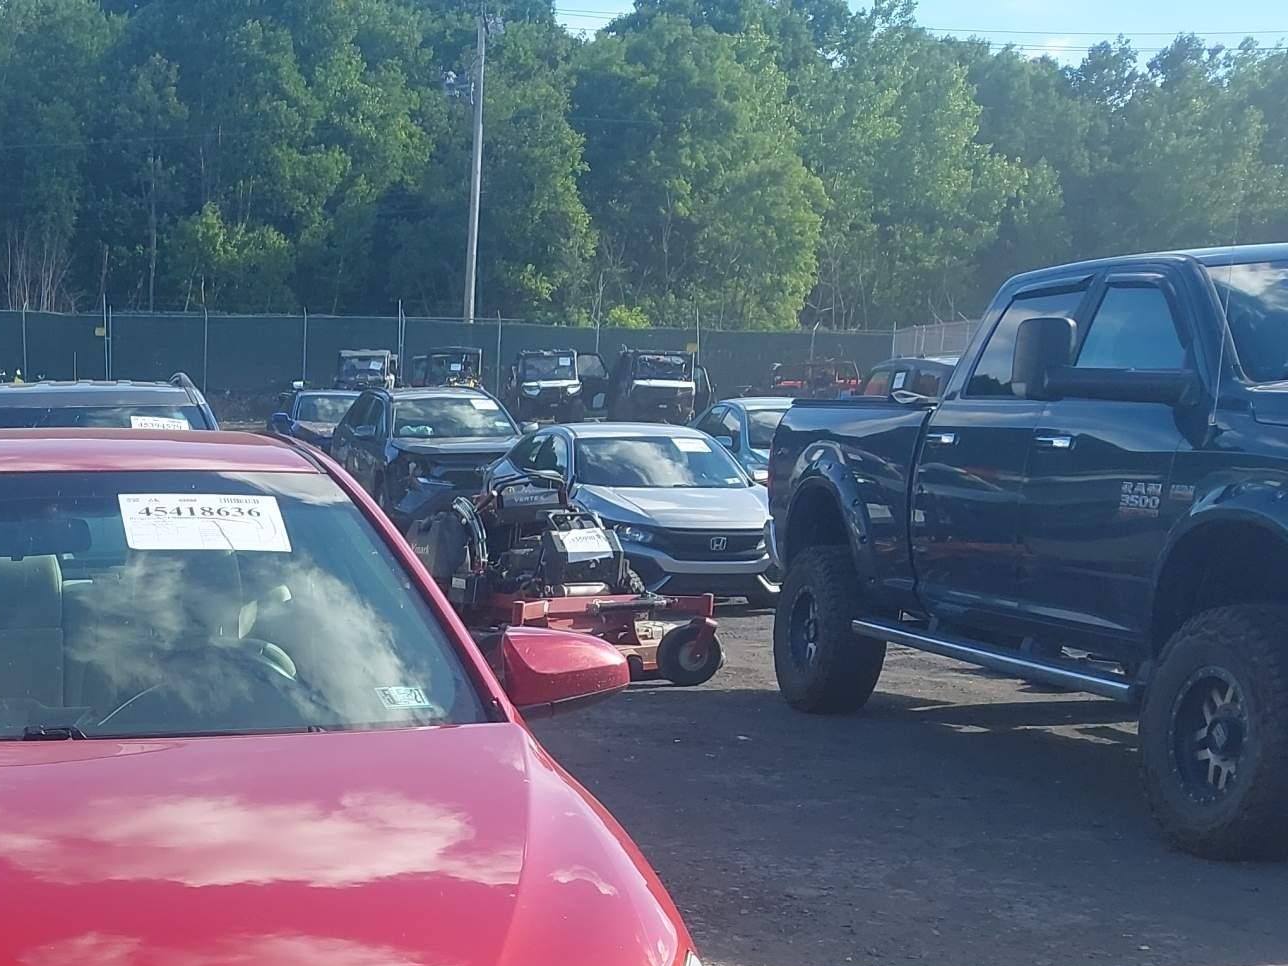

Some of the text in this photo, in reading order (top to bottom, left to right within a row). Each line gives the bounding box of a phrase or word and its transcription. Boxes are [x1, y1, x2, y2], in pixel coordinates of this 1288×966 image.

[1120, 481, 1162, 496] RAM
[1119, 494, 1160, 509] 3500
[138, 506, 261, 518] 45418636
